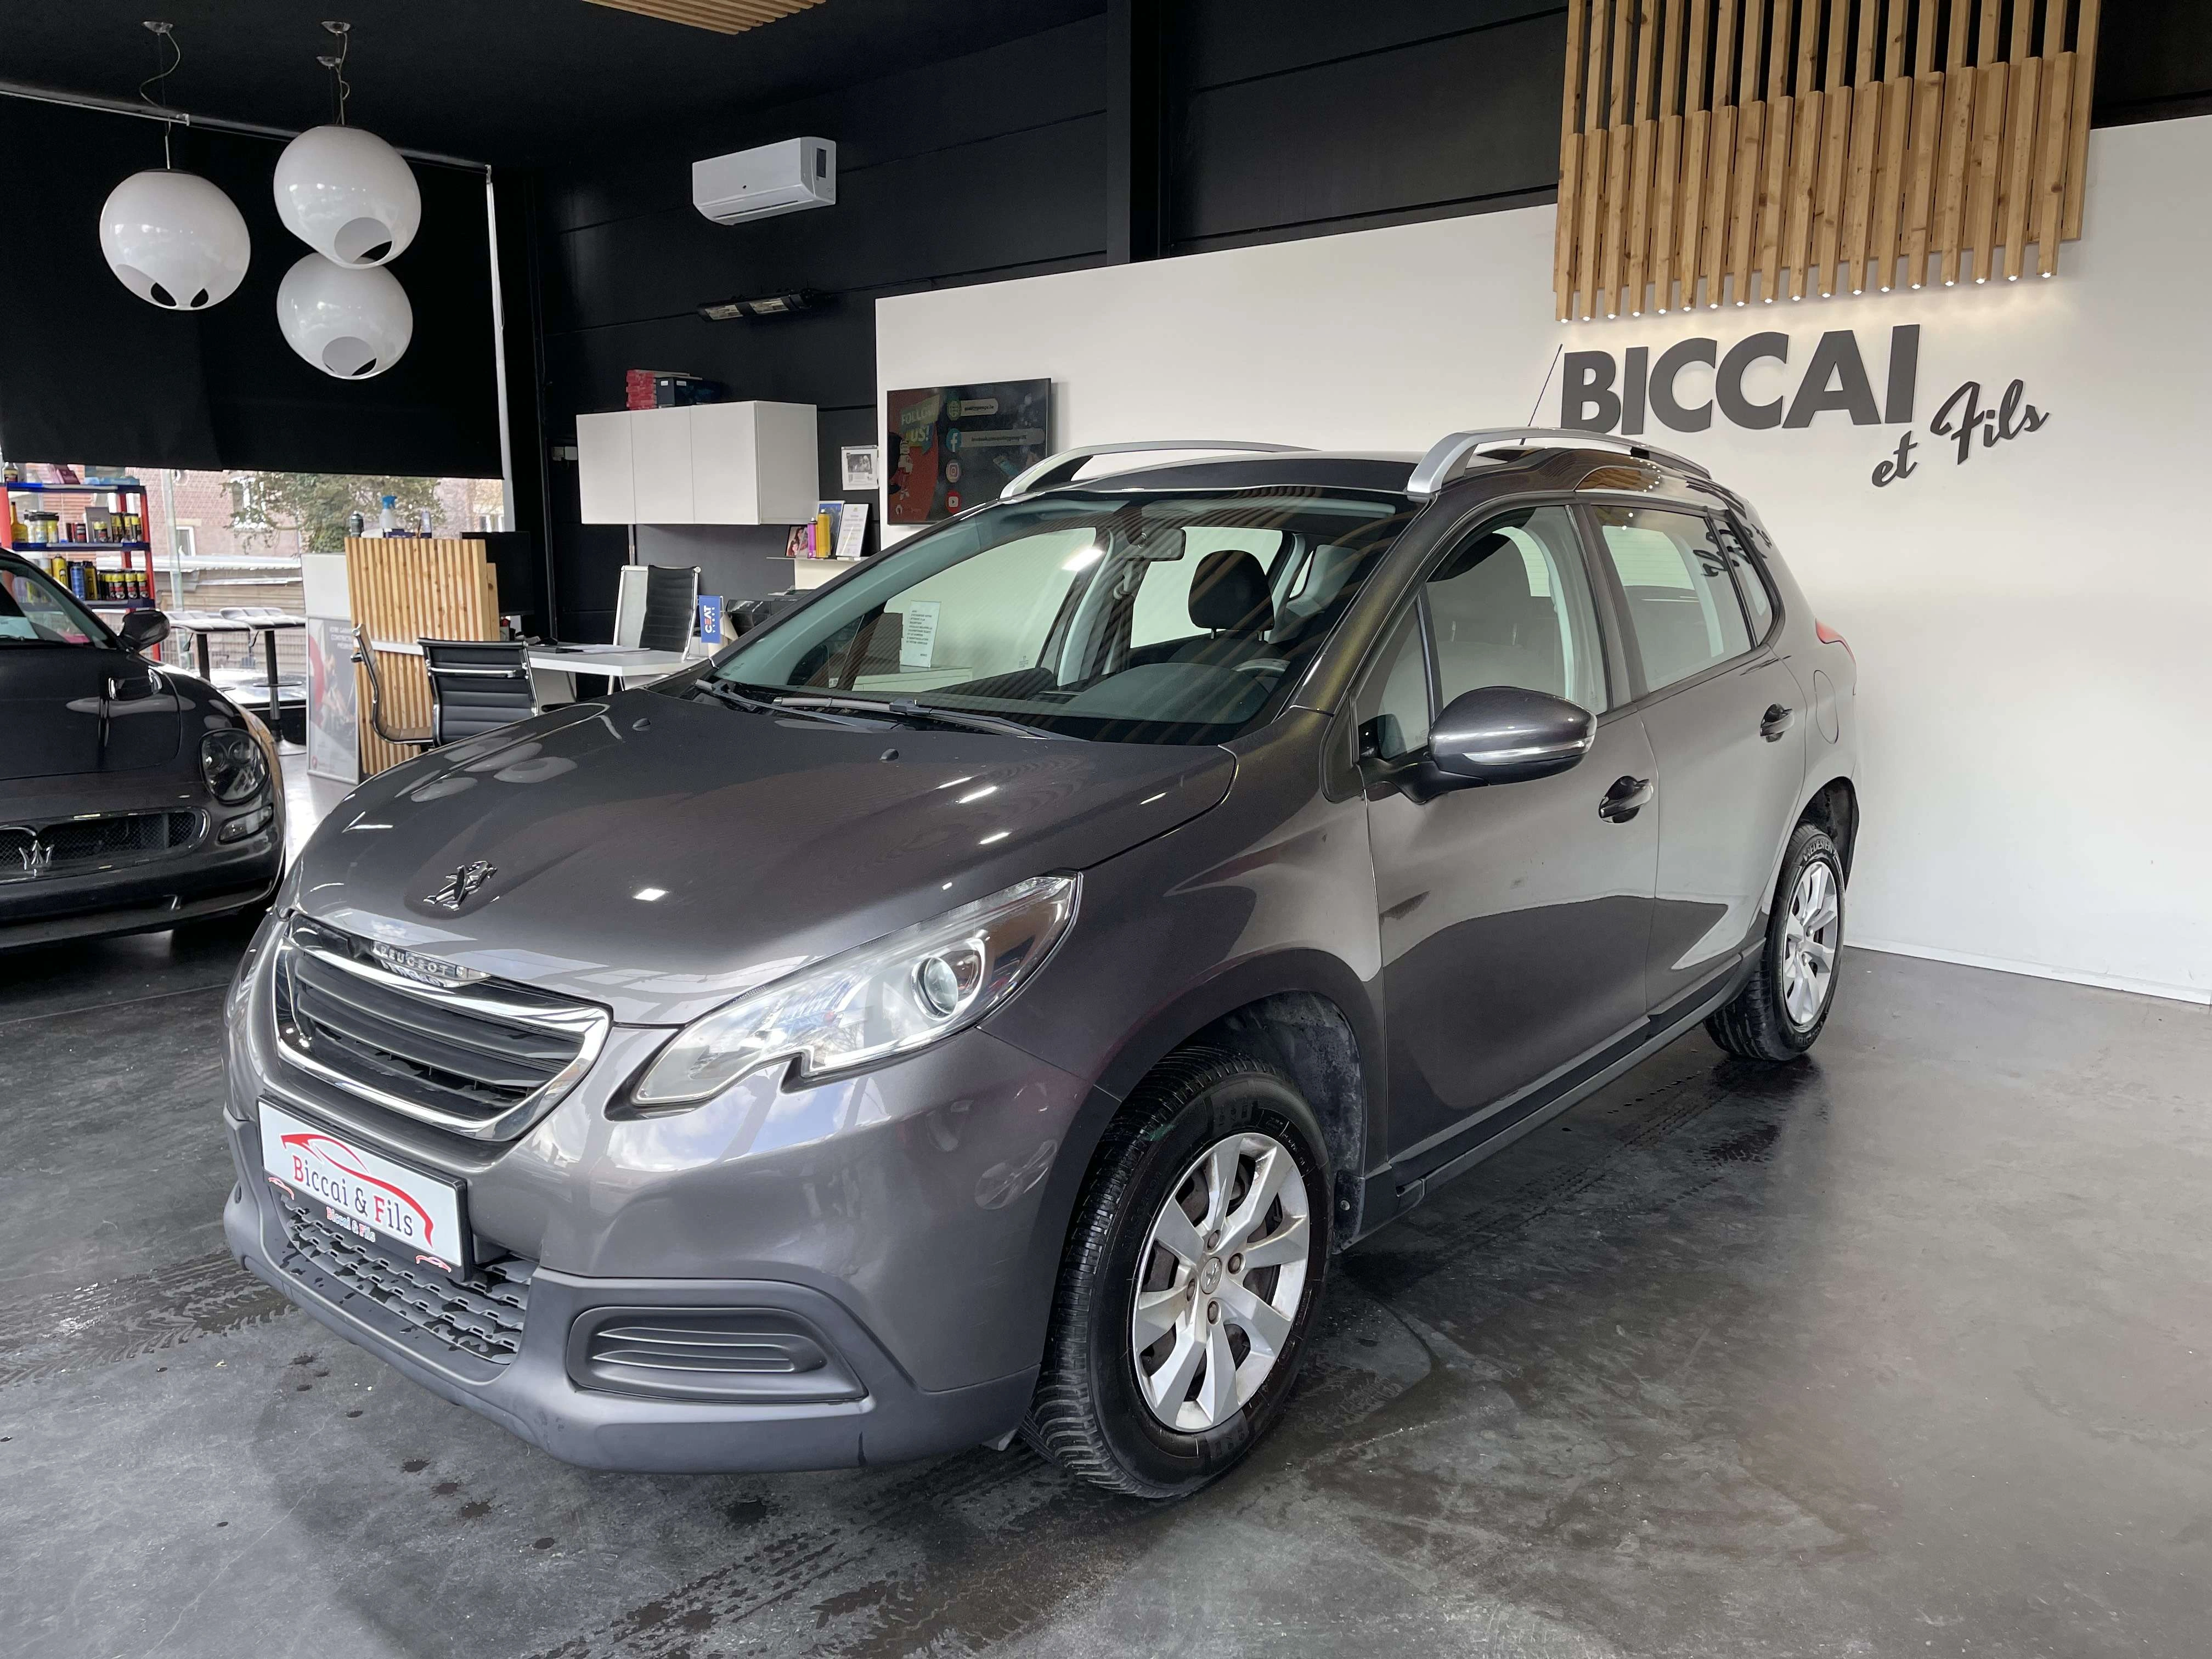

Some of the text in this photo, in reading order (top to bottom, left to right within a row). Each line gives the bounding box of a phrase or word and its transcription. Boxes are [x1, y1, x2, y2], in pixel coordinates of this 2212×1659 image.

[1560, 324, 1920, 435] BICCAI
[1871, 379, 2050, 488] et Fils
[703, 605, 713, 634] CEAT
[380, 943, 449, 977] PEUGEOT
[292, 1155, 413, 1237] Biccai & Fils
